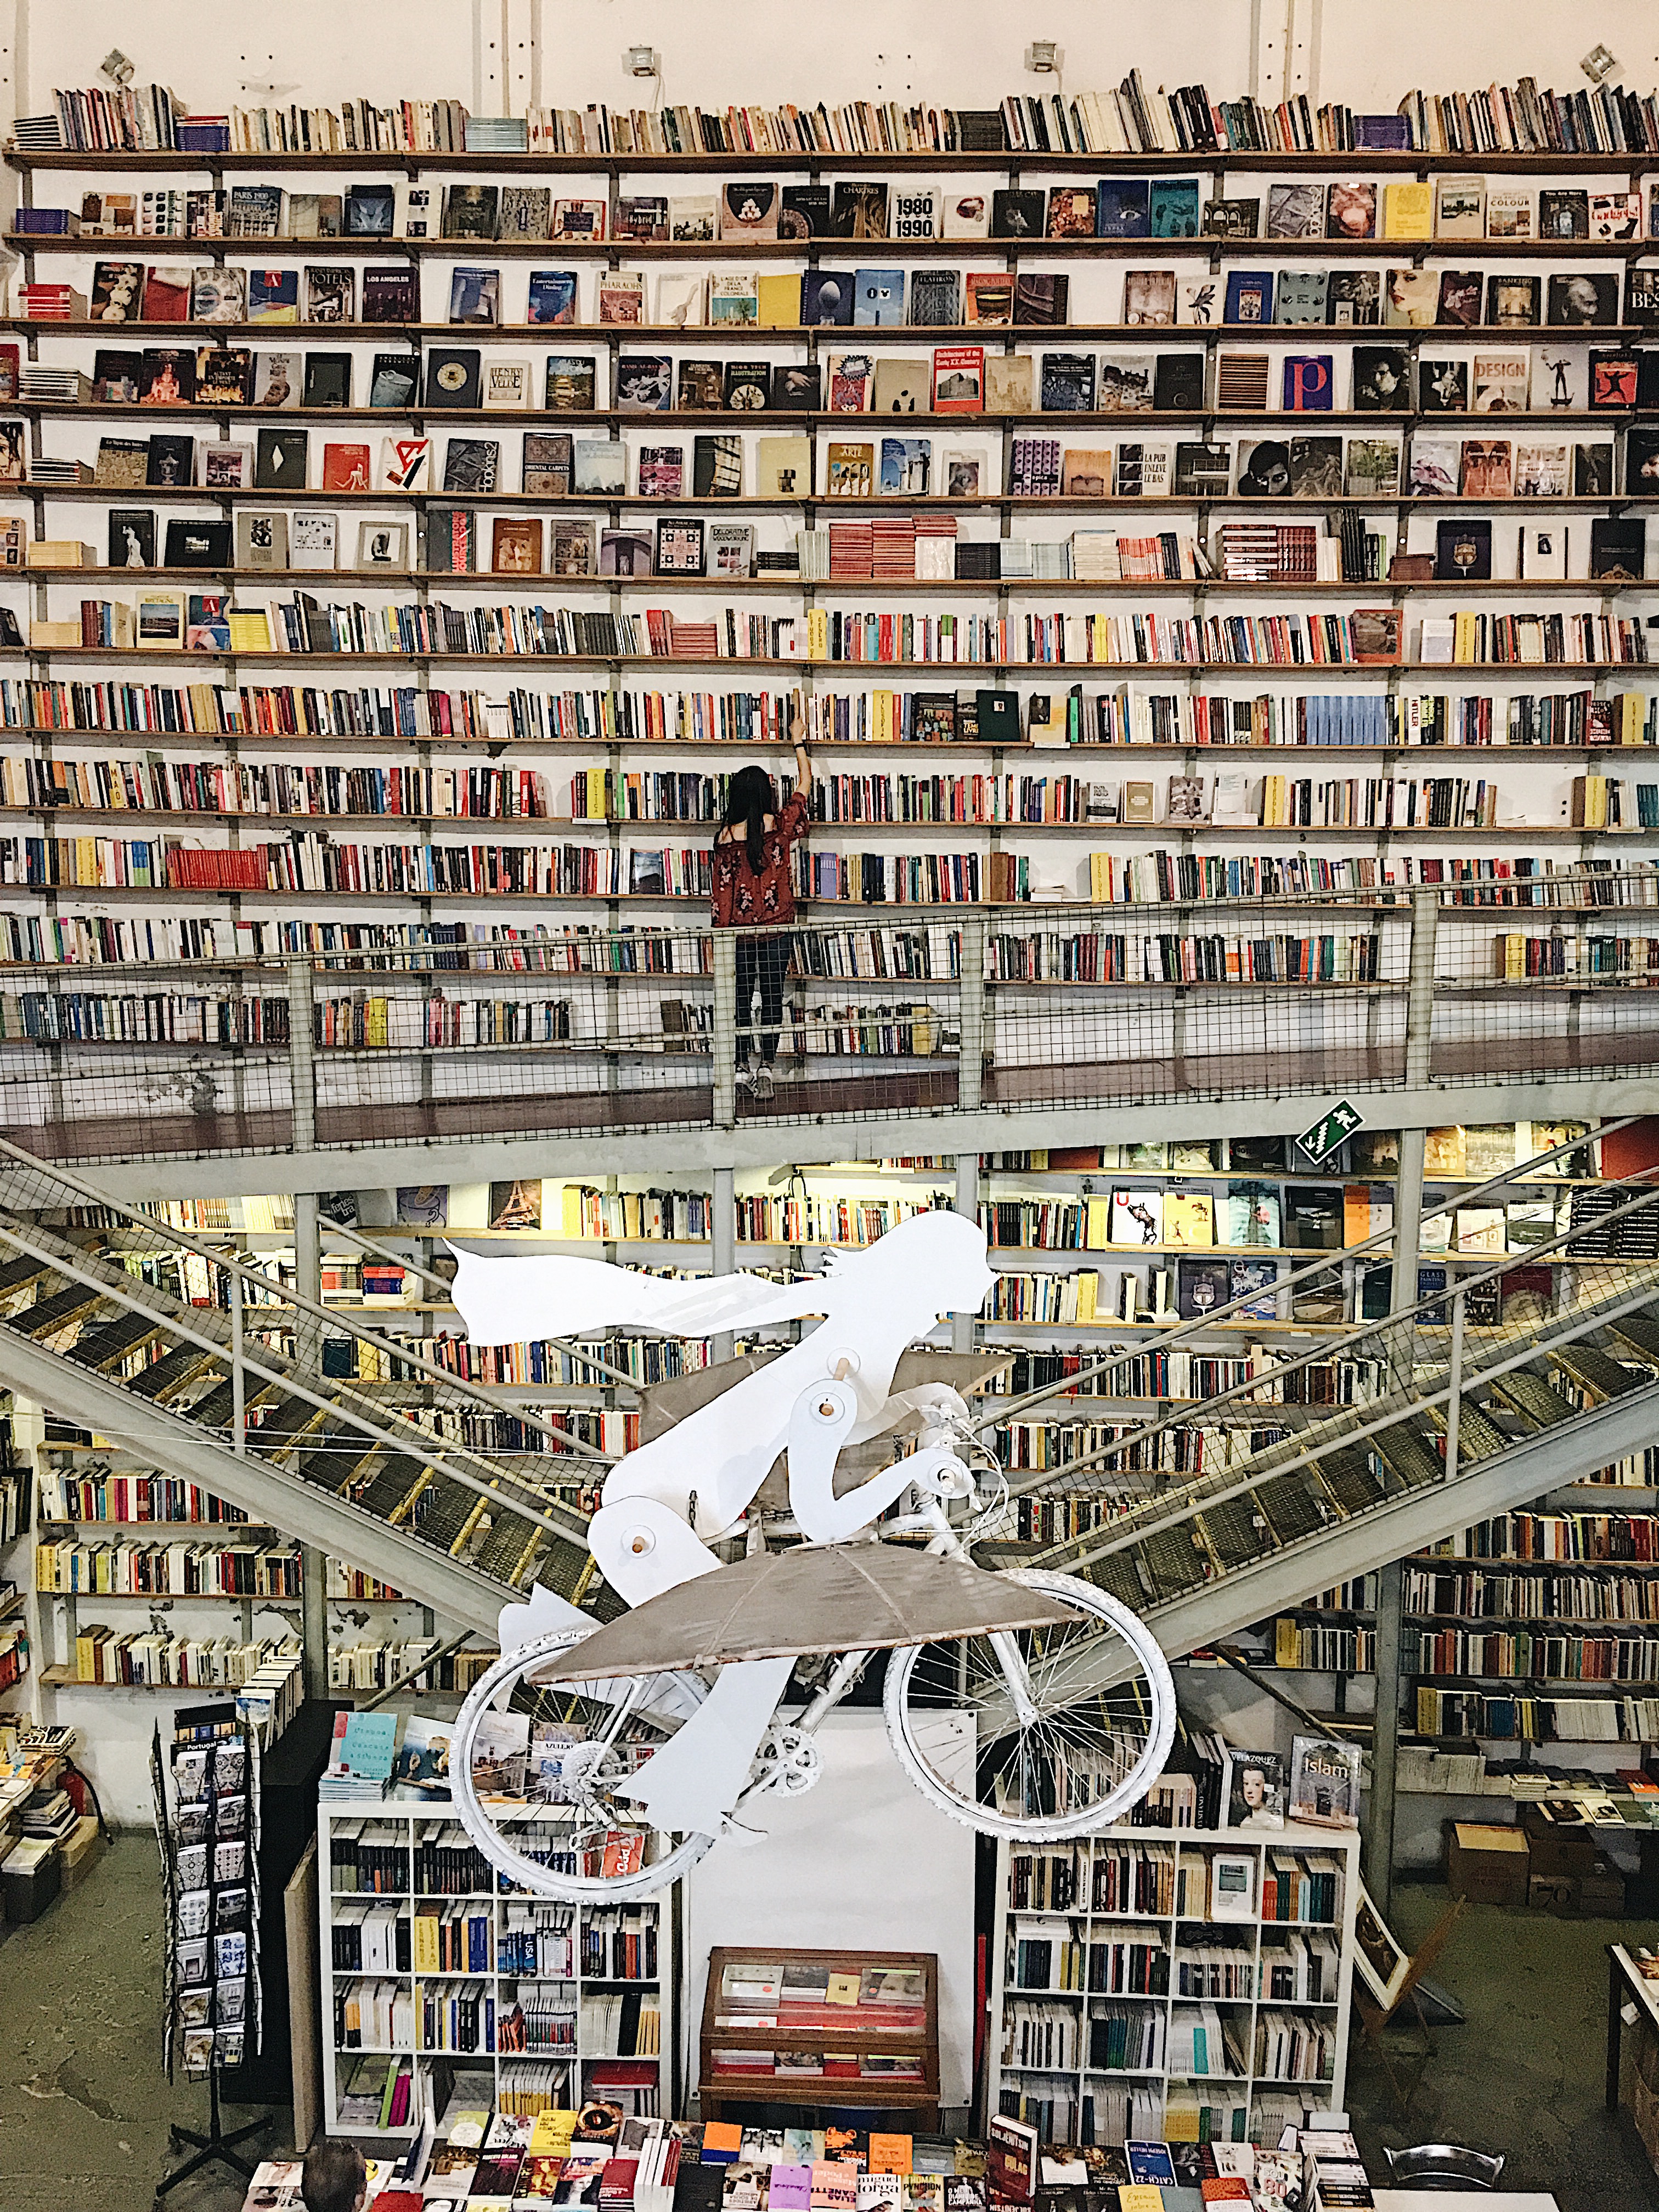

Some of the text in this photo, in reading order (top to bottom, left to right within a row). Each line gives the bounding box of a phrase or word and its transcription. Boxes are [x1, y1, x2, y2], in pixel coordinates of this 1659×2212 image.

[896, 198, 933, 216] 1980
[895, 219, 933, 237] 1990
[308, 274, 352, 285] HOTELS
[1476, 362, 1525, 377] DESIGN
[1144, 453, 1166, 462] LA PUB
[1144, 473, 1164, 483] LE BAS
[187, 1741, 217, 1752] Portugal
[1305, 1757, 1348, 1779] Islam
[525, 1941, 534, 1959] USA
[857, 2174, 899, 2186] miguel
[1135, 2175, 1173, 2185] CATCH-22
[857, 2183, 900, 2197] torga
[903, 2182, 941, 2192] PYNCHON
[827, 2194, 857, 2203] ELIAS
